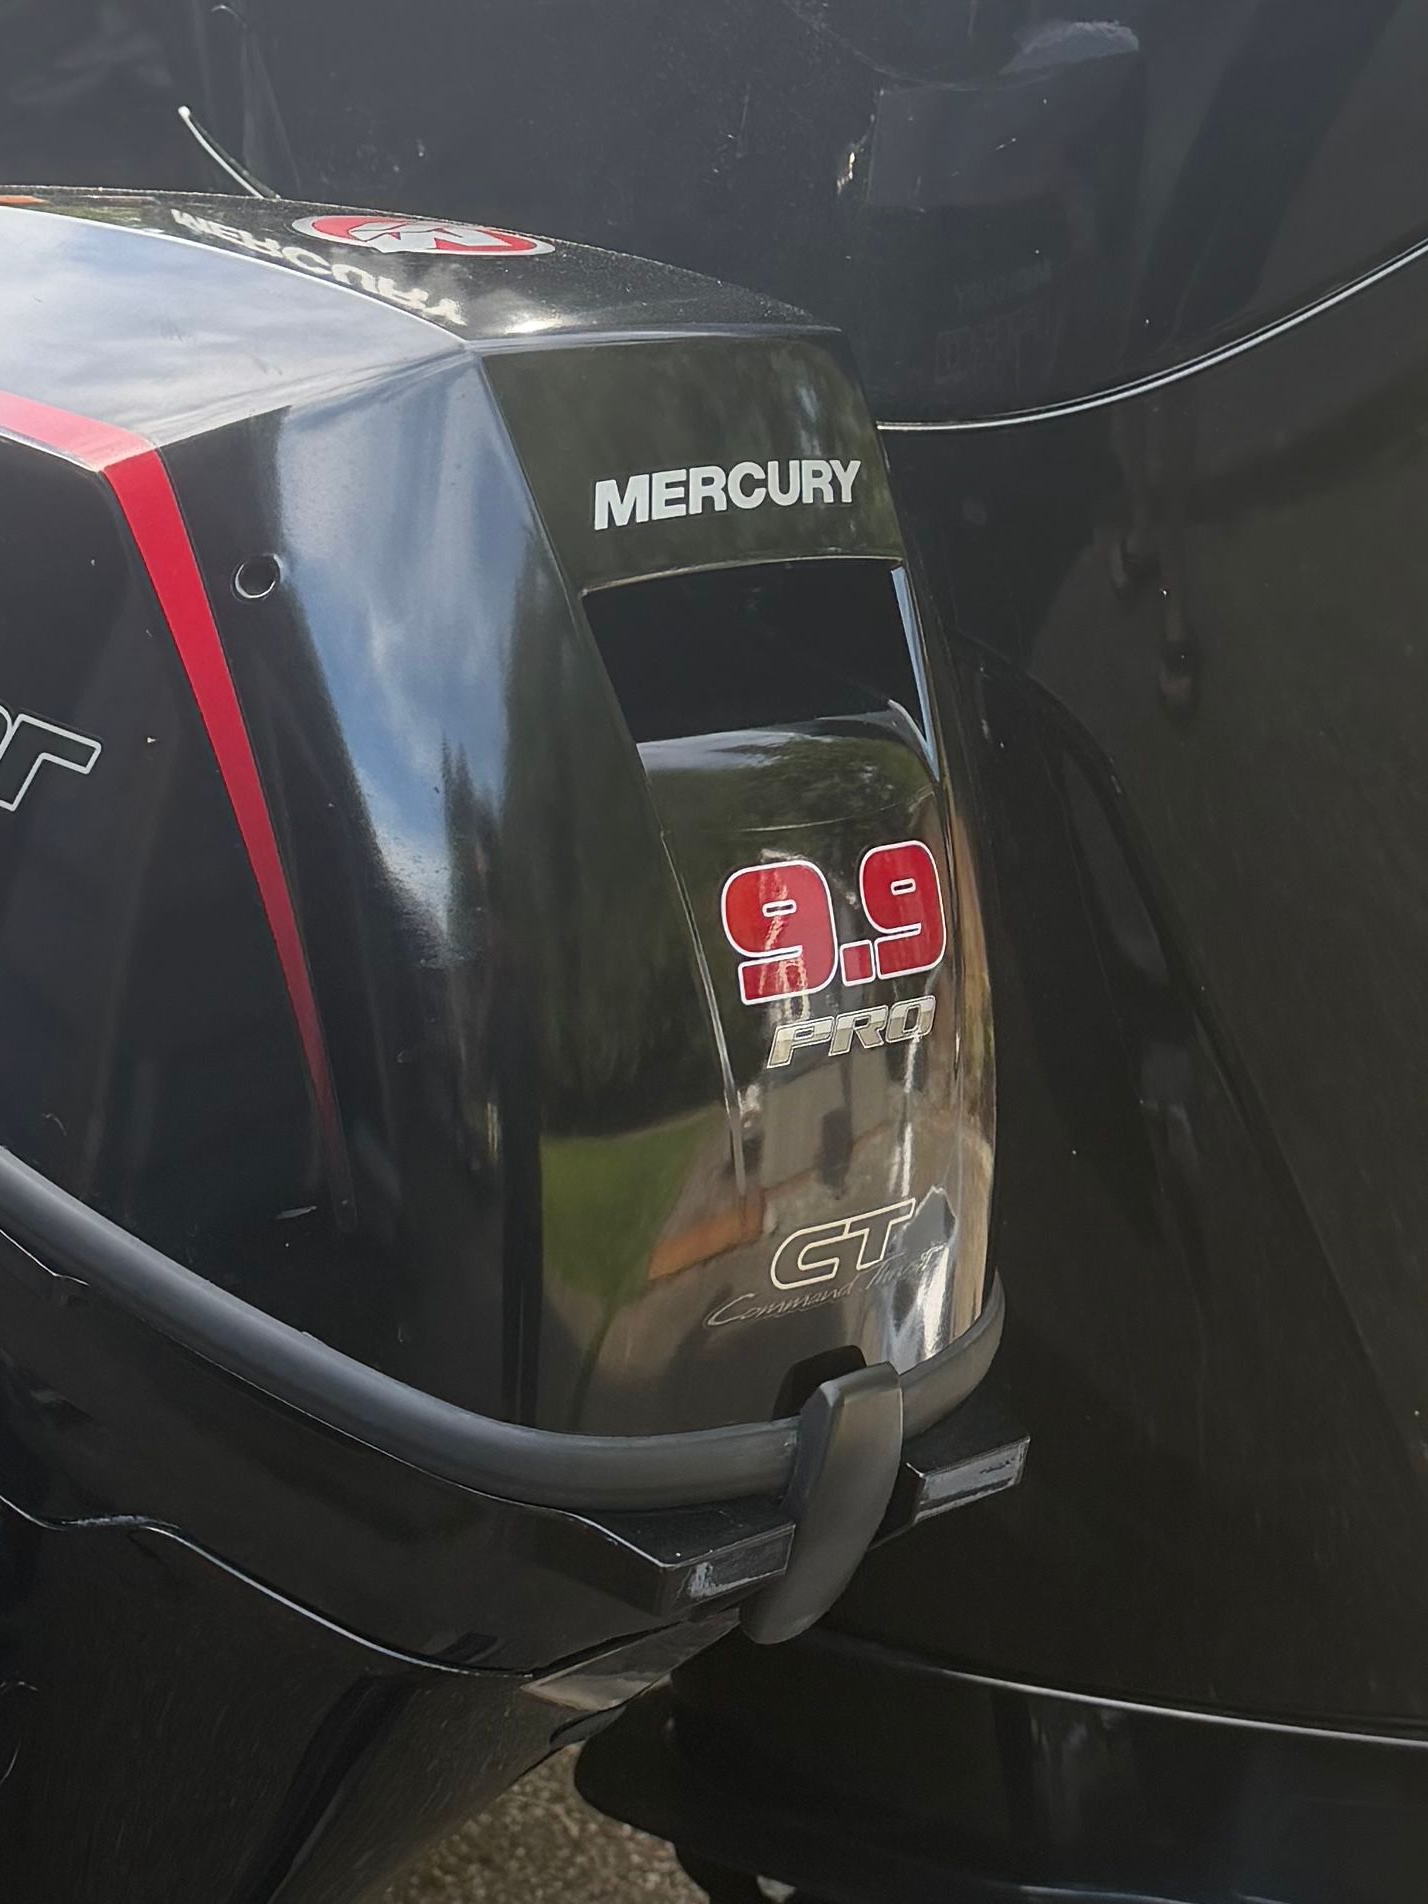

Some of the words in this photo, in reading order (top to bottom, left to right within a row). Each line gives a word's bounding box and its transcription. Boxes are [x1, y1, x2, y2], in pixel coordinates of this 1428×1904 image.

[593, 460, 861, 530] MERCURY
[720, 839, 948, 1006] 9.9
[767, 994, 937, 1069] PRO
